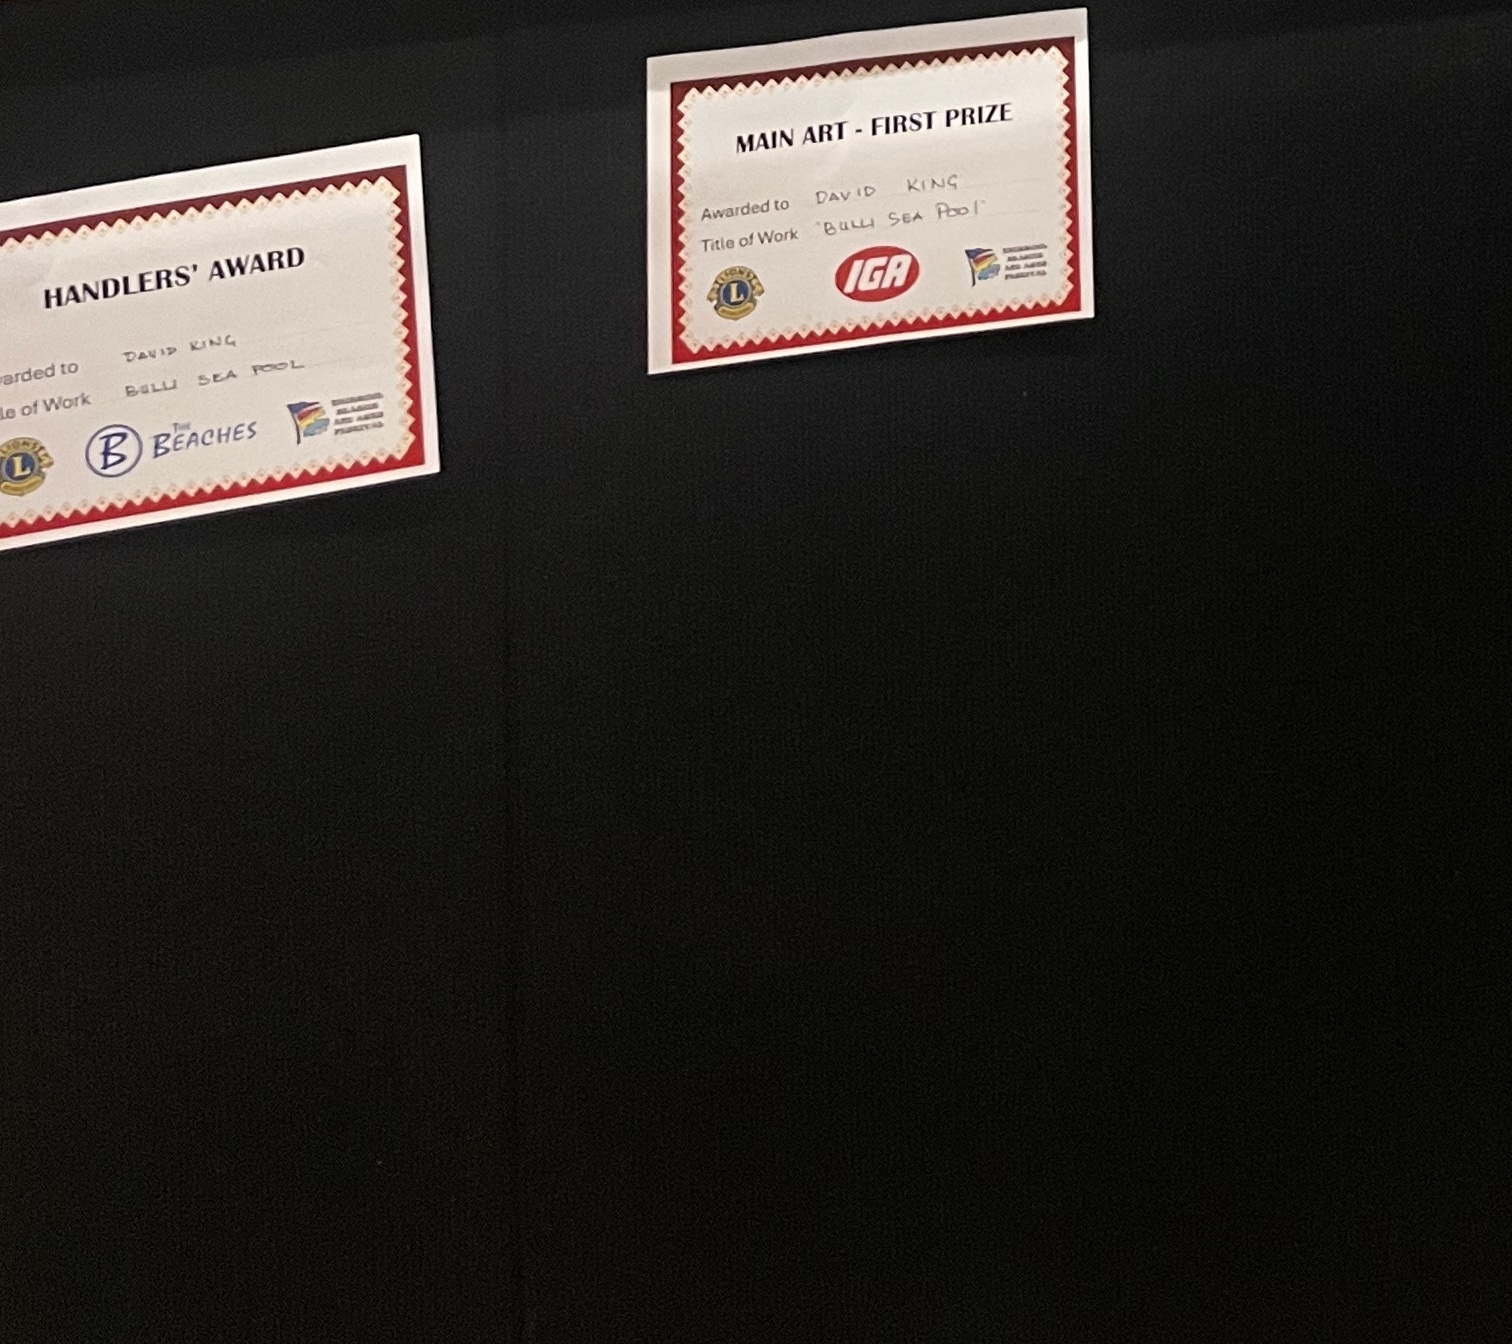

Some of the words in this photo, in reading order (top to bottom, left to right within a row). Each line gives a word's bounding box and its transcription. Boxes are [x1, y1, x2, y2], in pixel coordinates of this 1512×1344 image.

[736, 128, 794, 154] MAIN
[802, 120, 849, 145] ART
[871, 110, 937, 137] FIRST
[945, 101, 1013, 128] PRIZE
[815, 185, 876, 205] DAVID
[906, 173, 958, 192] KING
[701, 199, 770, 221] Awarded
[774, 200, 790, 211] to
[888, 211, 923, 226] SEA
[701, 237, 735, 252] Title
[738, 232, 754, 247] of
[757, 227, 799, 244] Work
[44, 264, 198, 309] HANDLERS'
[208, 247, 305, 282] AWARD
[843, 254, 912, 294] IGA
[730, 283, 745, 303] L
[123, 346, 177, 362] DAVID
[189, 334, 237, 352] KING
[60, 363, 79, 375] to
[125, 379, 178, 397] BULLI
[198, 369, 238, 387] SEA
[251, 360, 306, 376] POOL
[21, 399, 38, 416] of
[42, 392, 92, 412] Work
[98, 432, 129, 470] B
[153, 421, 257, 459] BEACHES
[13, 455, 31, 477] L
